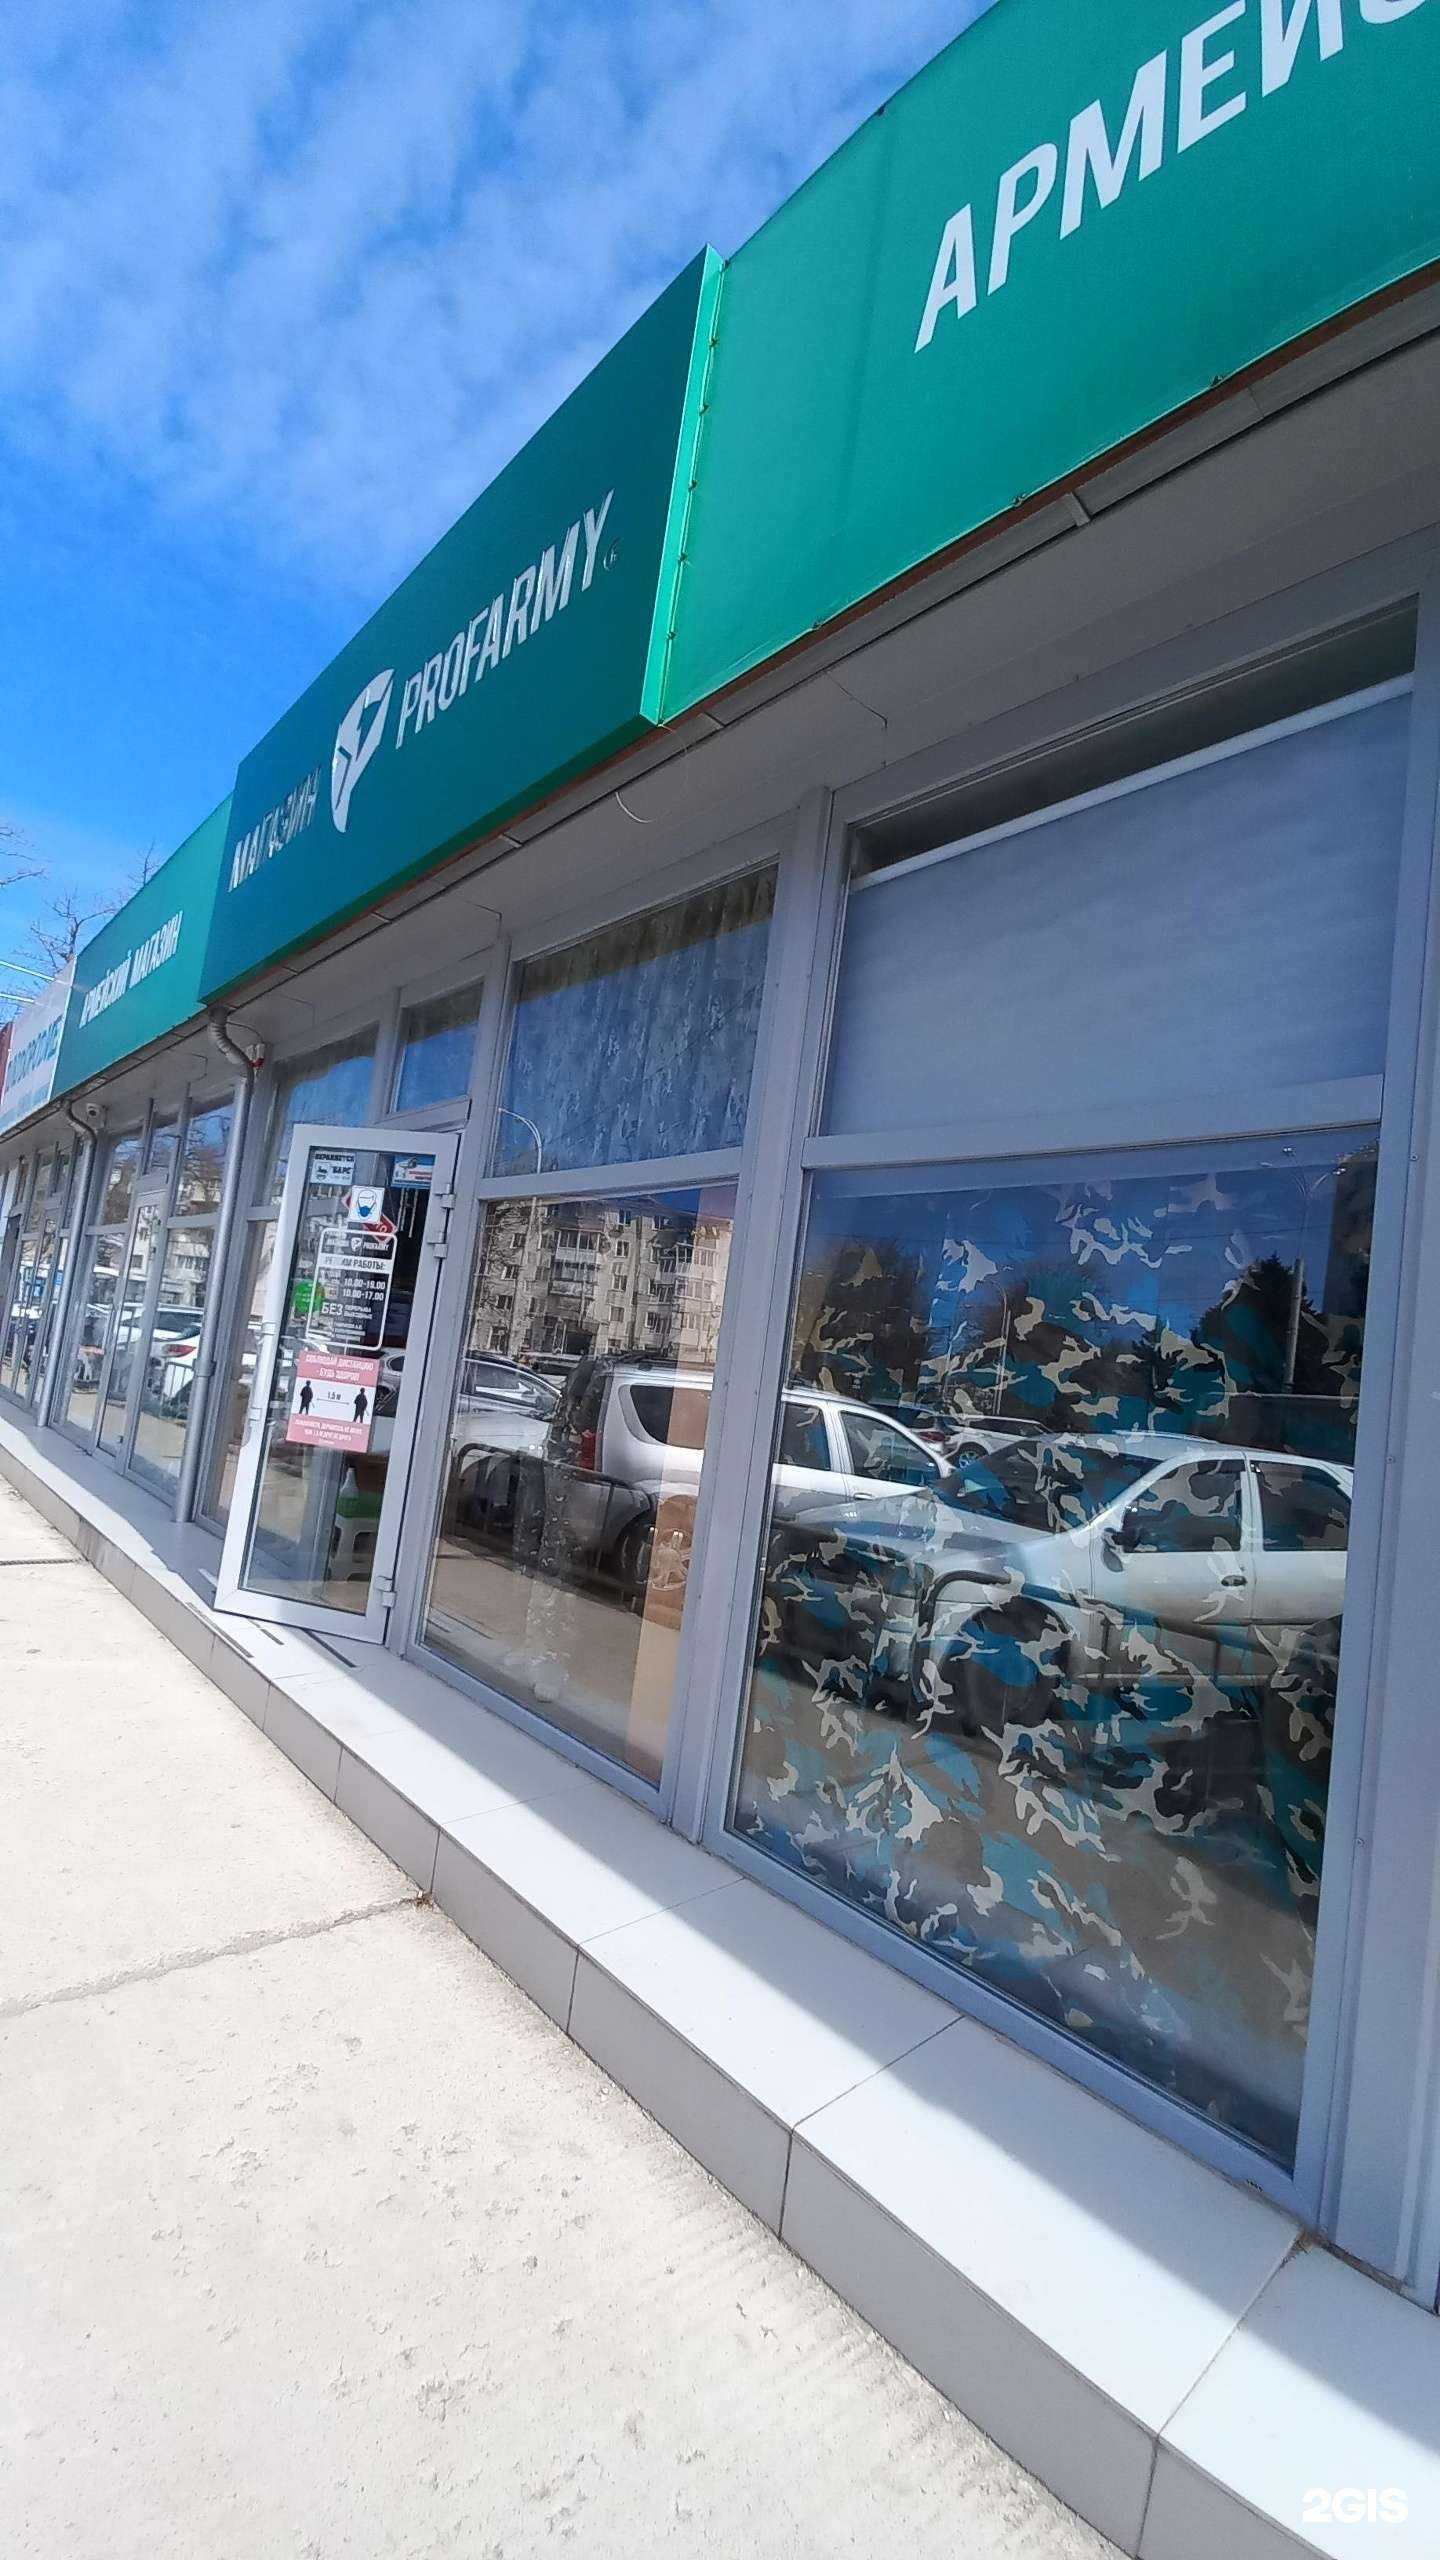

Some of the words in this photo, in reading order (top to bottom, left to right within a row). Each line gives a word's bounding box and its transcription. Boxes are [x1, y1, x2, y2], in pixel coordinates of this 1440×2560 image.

[914, 0, 1428, 353] АРМЕ
[395, 488, 615, 750] PROFARMY
[228, 767, 321, 893] МАГАЗИН
[321, 1302, 343, 1316] БЕЗ
